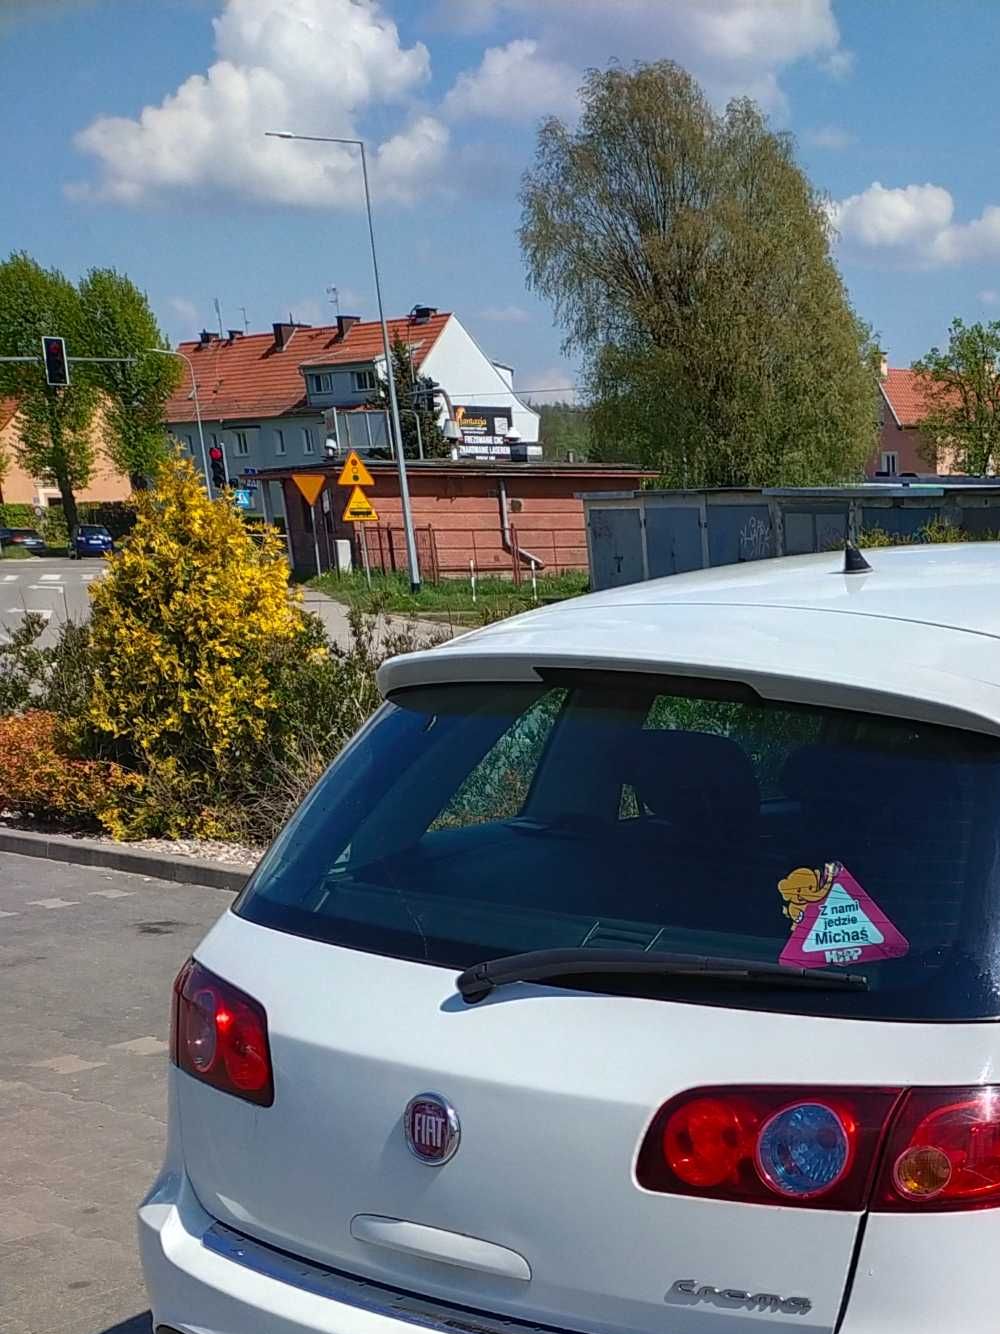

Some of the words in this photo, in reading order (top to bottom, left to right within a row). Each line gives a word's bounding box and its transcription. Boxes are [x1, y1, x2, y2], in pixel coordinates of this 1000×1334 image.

[820, 905, 829, 917] Z
[831, 901, 860, 915] nami
[823, 915, 859, 931] jedzie
[815, 926, 869, 946] Michaś
[414, 1112, 446, 1148] FIAT
